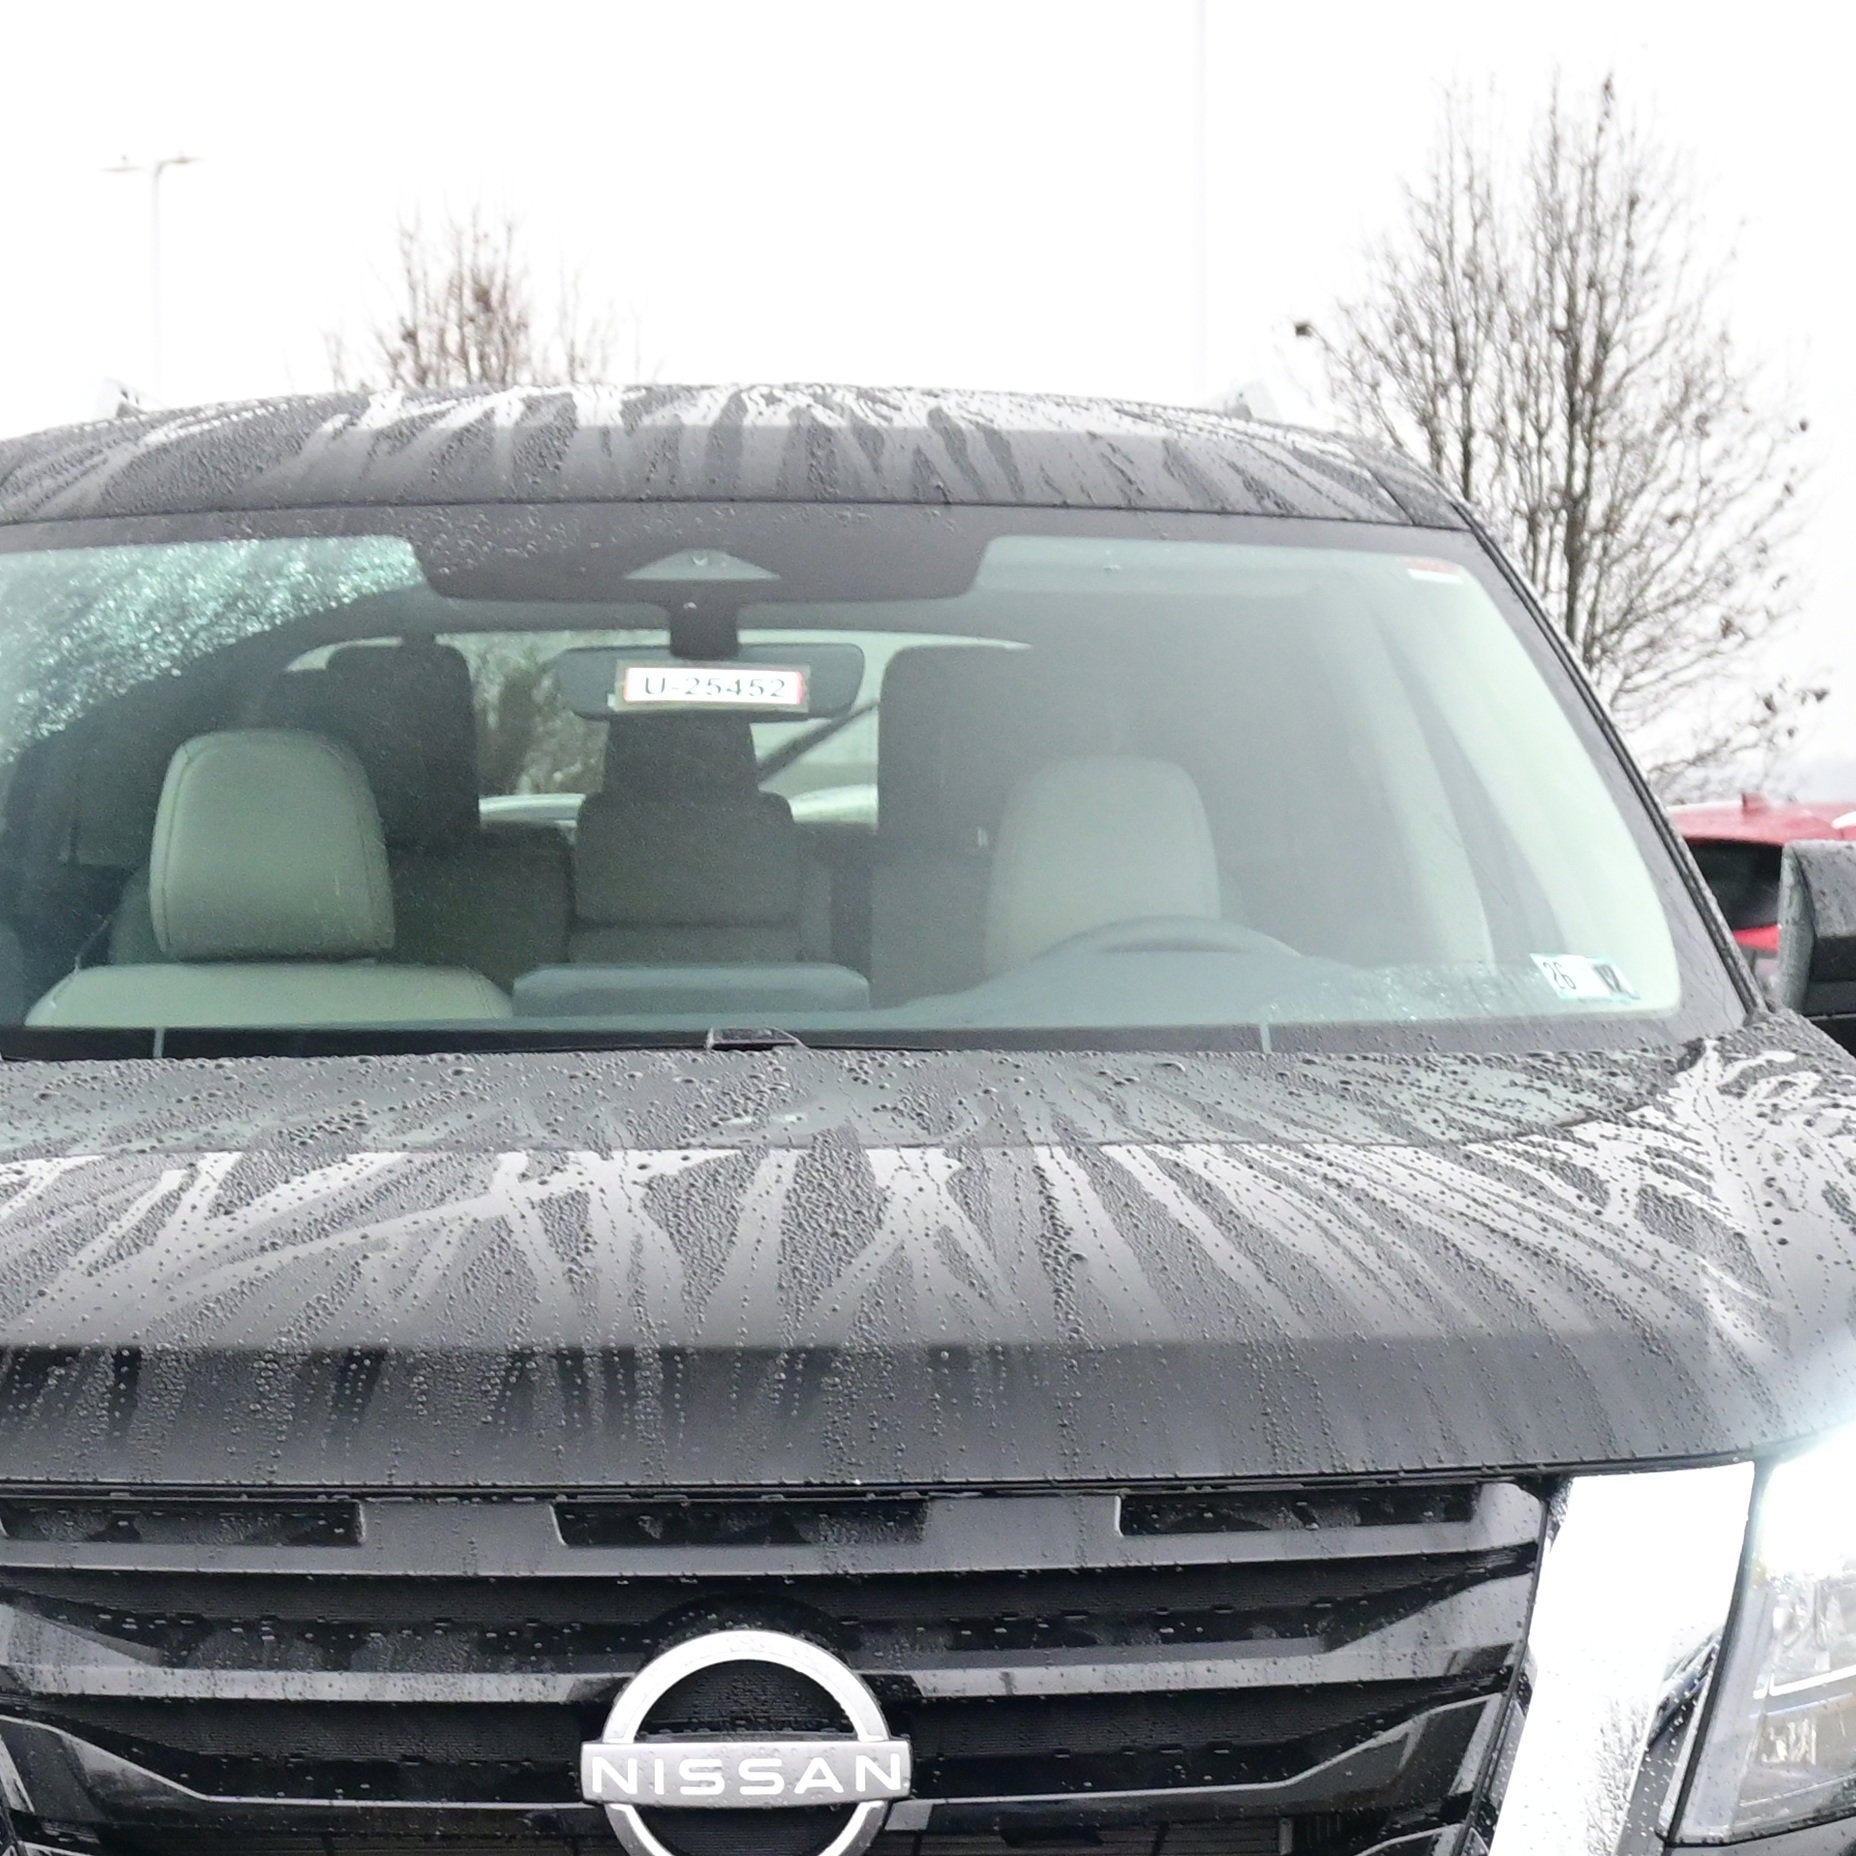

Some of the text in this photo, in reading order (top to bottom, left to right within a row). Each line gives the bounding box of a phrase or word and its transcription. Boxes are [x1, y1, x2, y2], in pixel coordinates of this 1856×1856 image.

[644, 676, 786, 698] U-25452
[1542, 961, 1577, 990] 26
[591, 1752, 902, 1796] NISSAN
